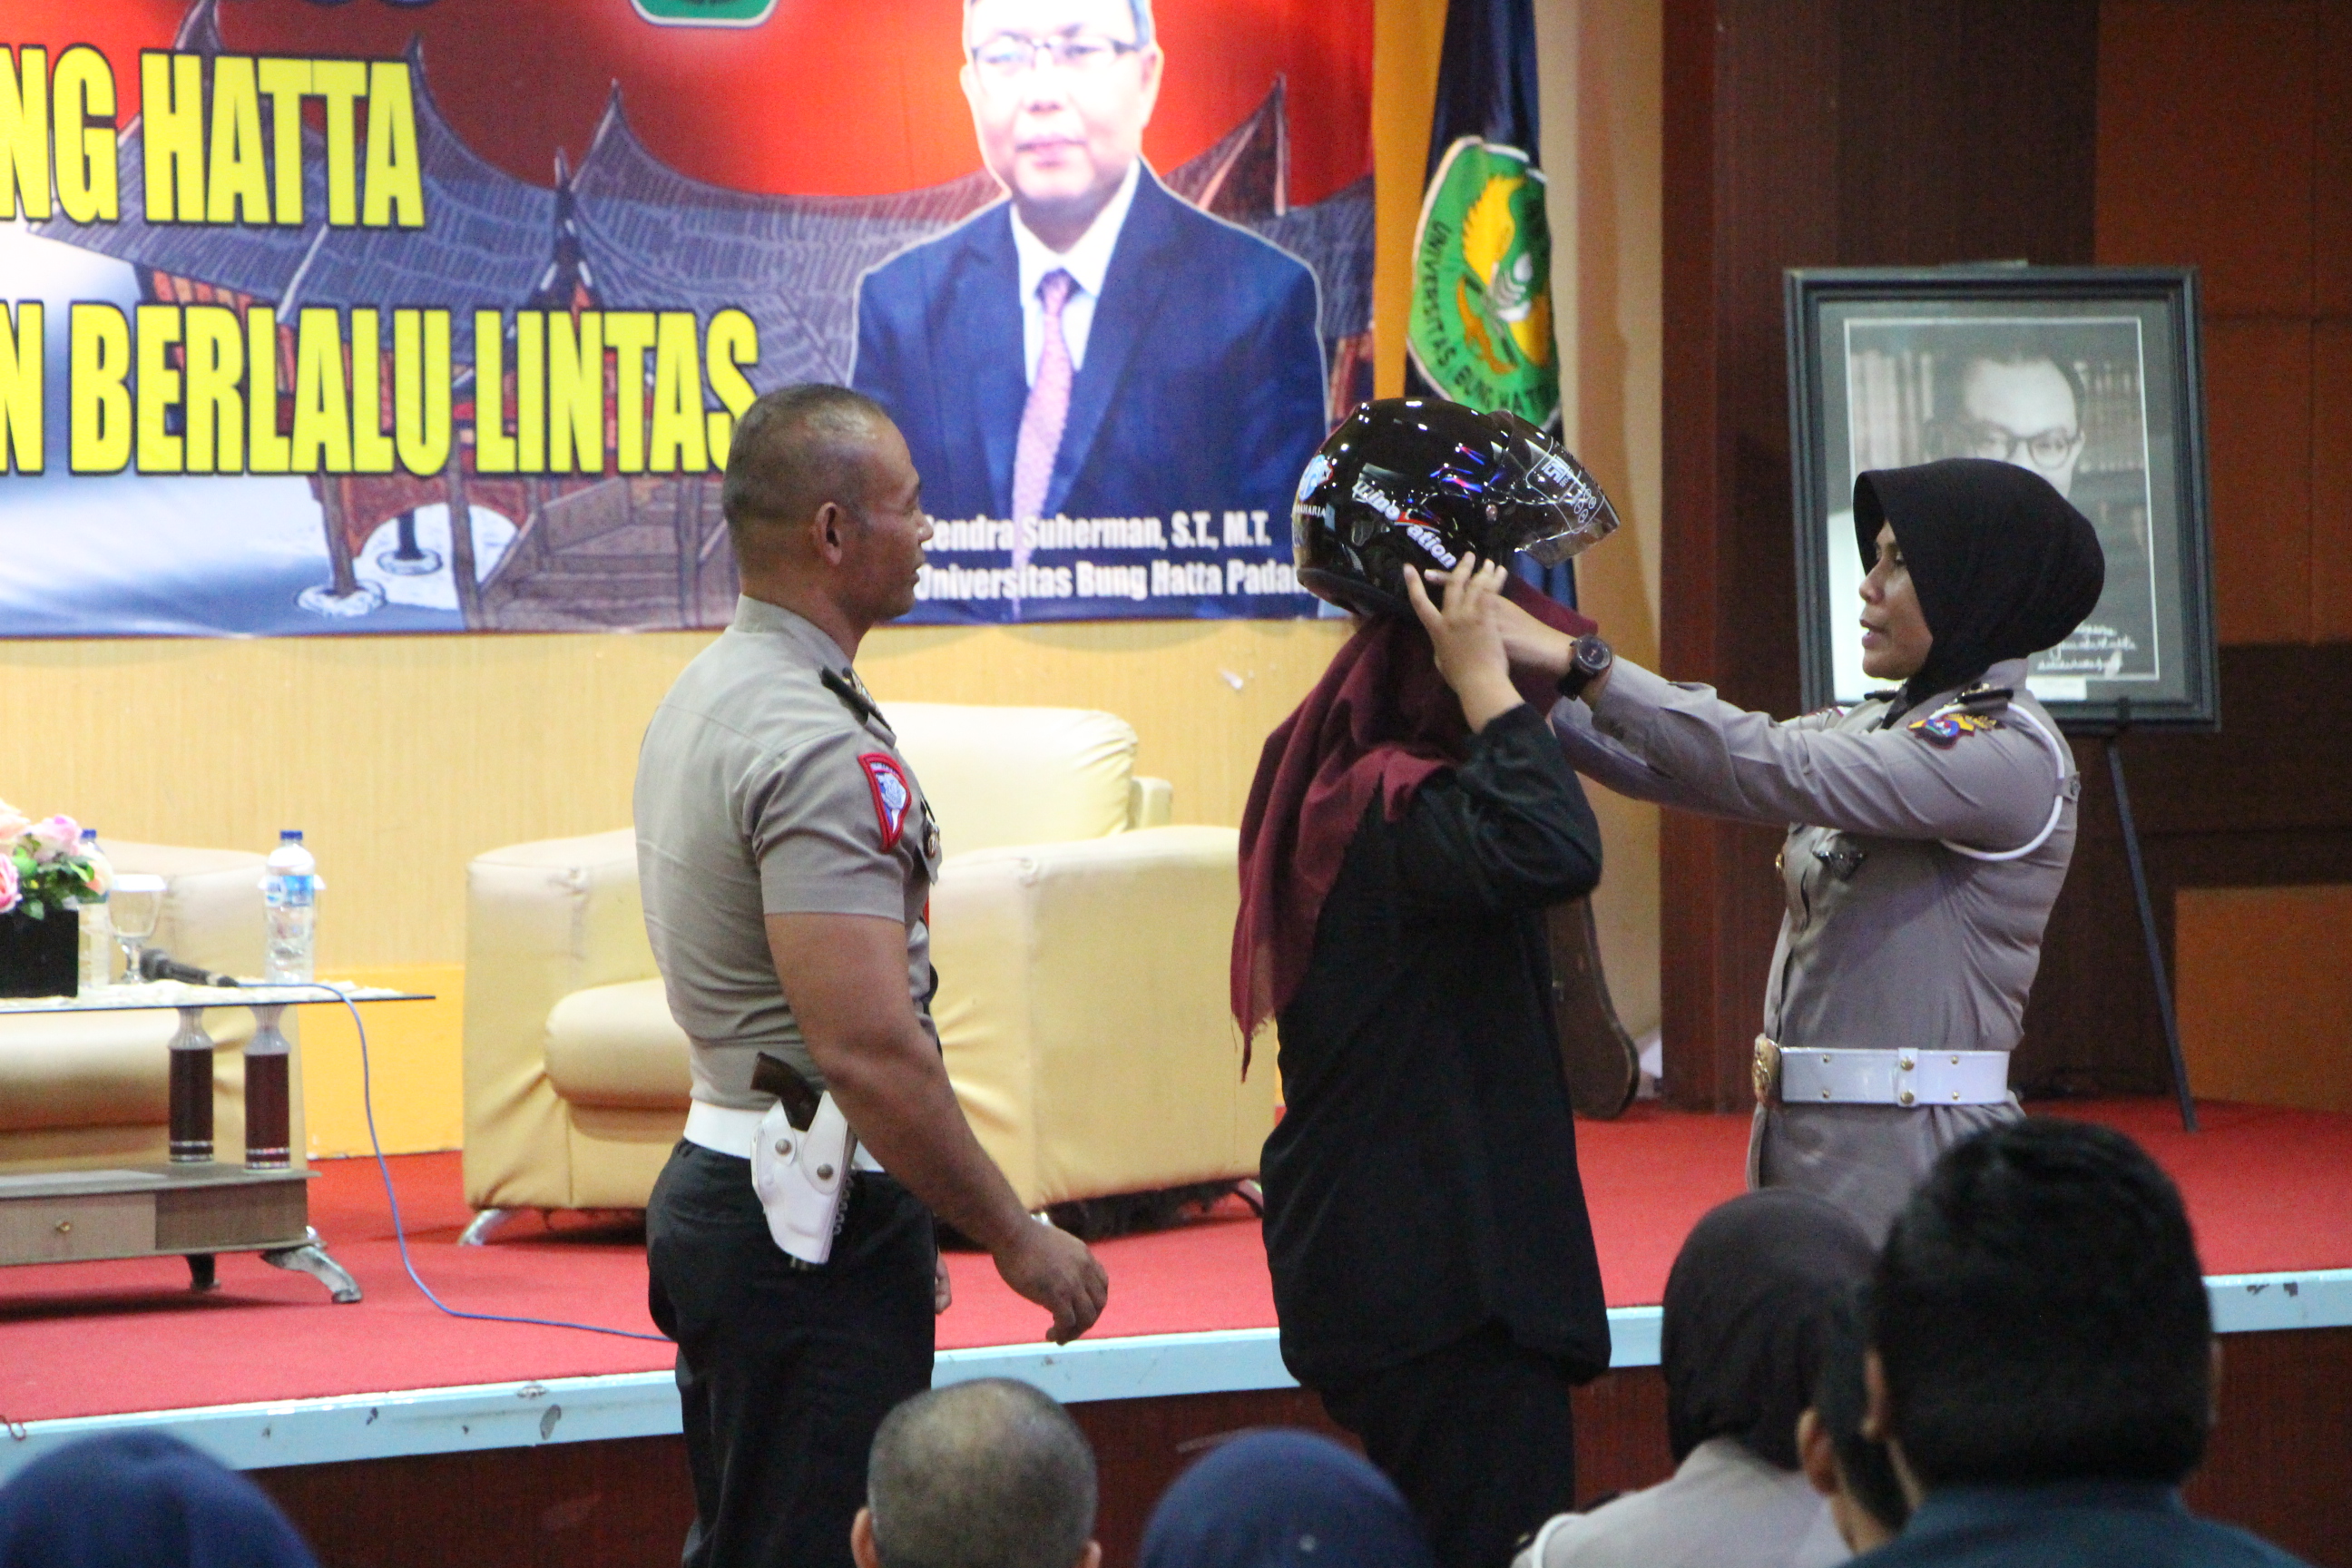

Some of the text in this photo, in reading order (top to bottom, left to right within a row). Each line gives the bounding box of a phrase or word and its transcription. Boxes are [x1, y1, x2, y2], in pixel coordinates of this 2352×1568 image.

[140, 50, 425, 227] HATTA
[69, 303, 452, 475] BERLALU
[475, 309, 759, 474] LINTAS
[913, 562, 1073, 601] Universitas
[1075, 560, 1148, 602] Bung
[1150, 559, 1223, 596] Hatta
[1021, 512, 1168, 551] Suherman,
[1171, 510, 1220, 550] S.T.,
[1224, 510, 1271, 547] M.T.
